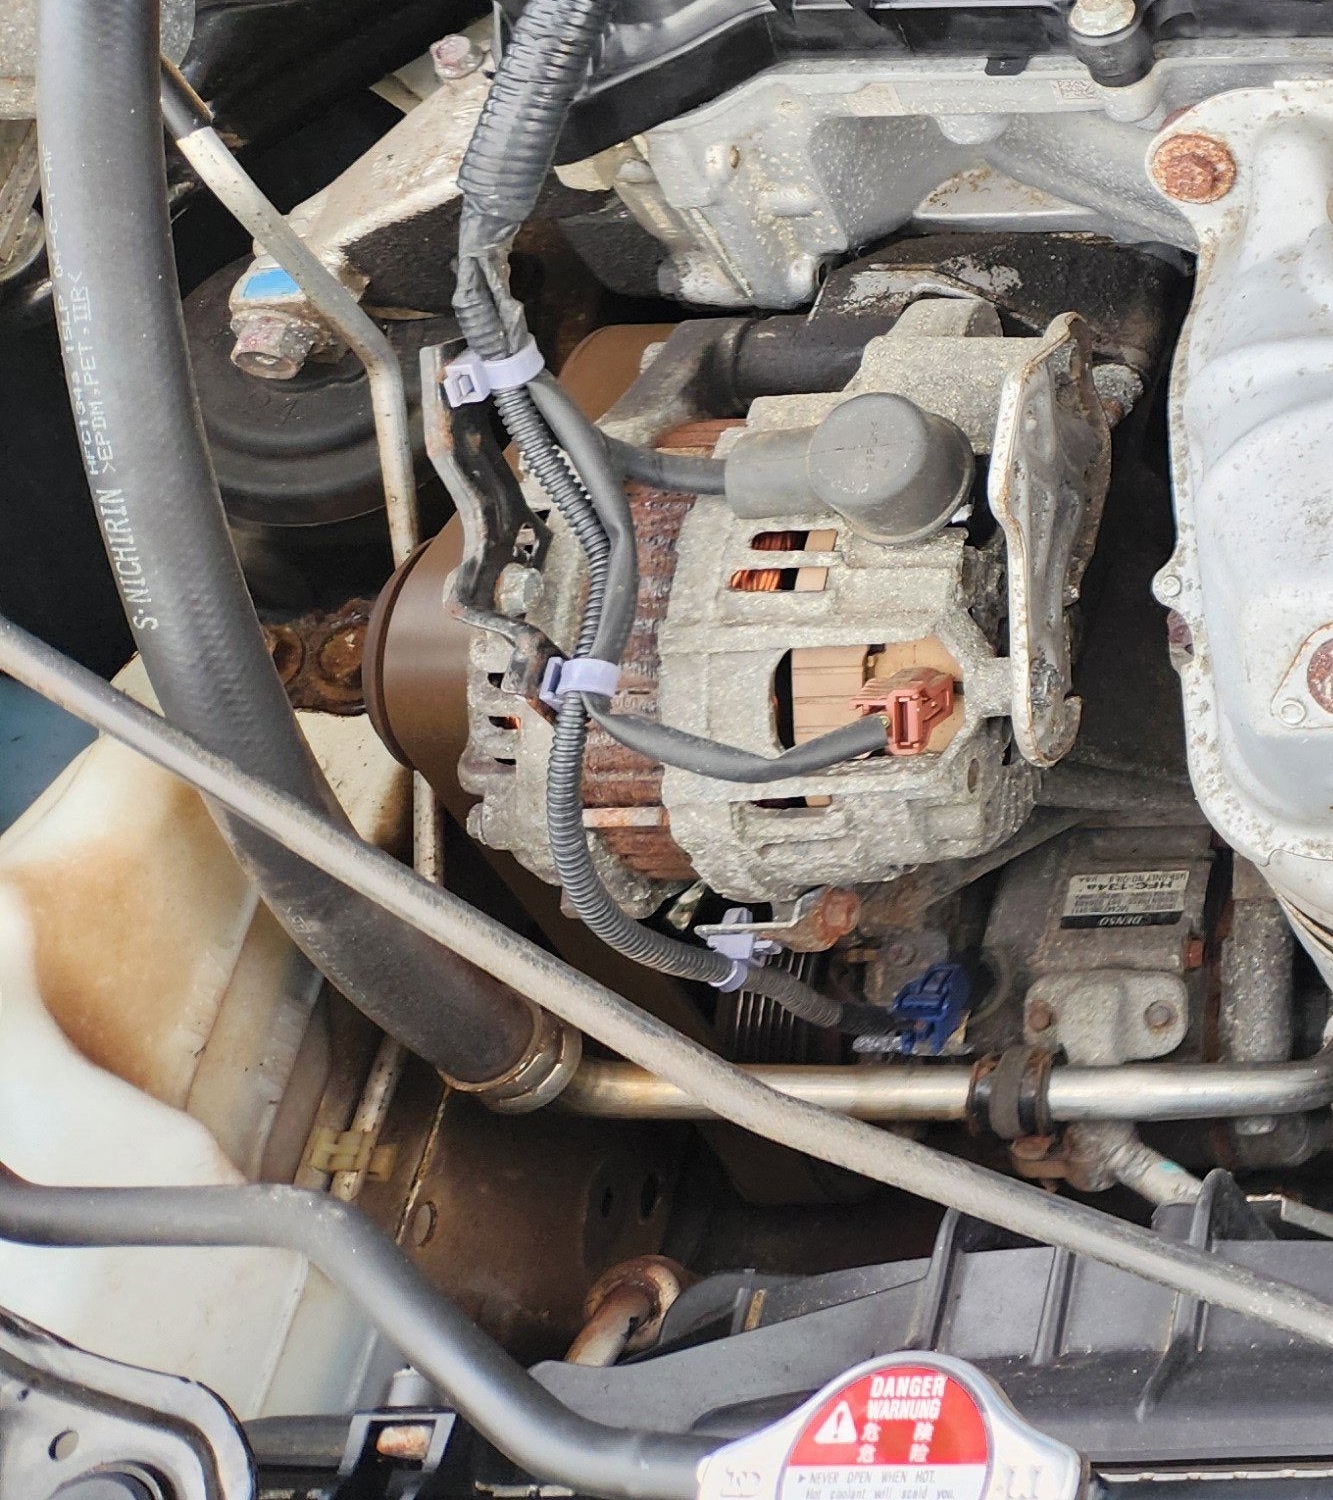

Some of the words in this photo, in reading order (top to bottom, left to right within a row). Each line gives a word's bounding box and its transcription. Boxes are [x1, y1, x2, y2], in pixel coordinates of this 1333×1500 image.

[1099, 916, 1144, 927] DENSO
[870, 1375, 948, 1398] DANGER
[866, 1399, 942, 1421] WARNUNG
[809, 1472, 840, 1483] NEVER
[846, 1471, 871, 1483] OPEN
[881, 1471, 907, 1483] WHEN
